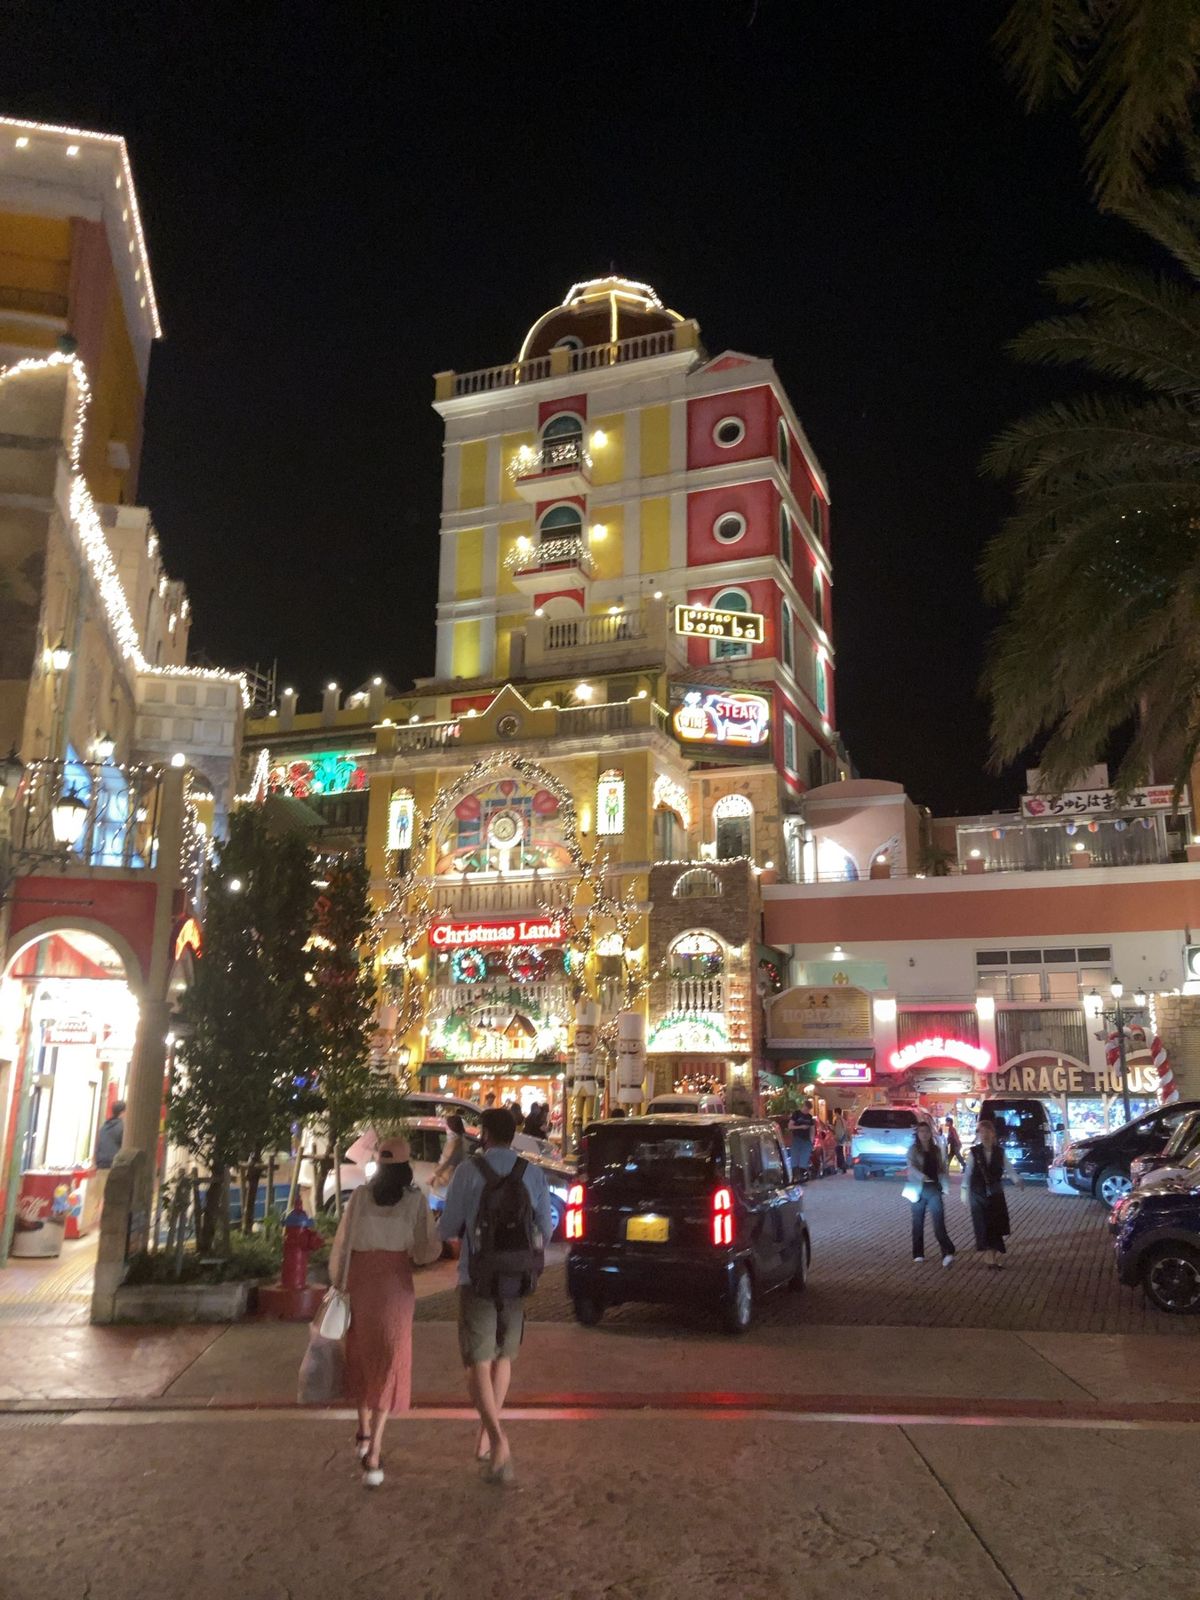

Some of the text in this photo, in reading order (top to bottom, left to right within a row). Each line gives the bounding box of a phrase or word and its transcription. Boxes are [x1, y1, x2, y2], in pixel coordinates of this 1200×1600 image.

[683, 610, 724, 635] bom
[688, 609, 732, 623] BISTRO
[715, 702, 759, 720] STEAK
[1048, 793, 1147, 814] ちゅらはま堂
[433, 920, 561, 944] Christmas Land
[991, 1065, 1160, 1093] GARAGE HOUS
